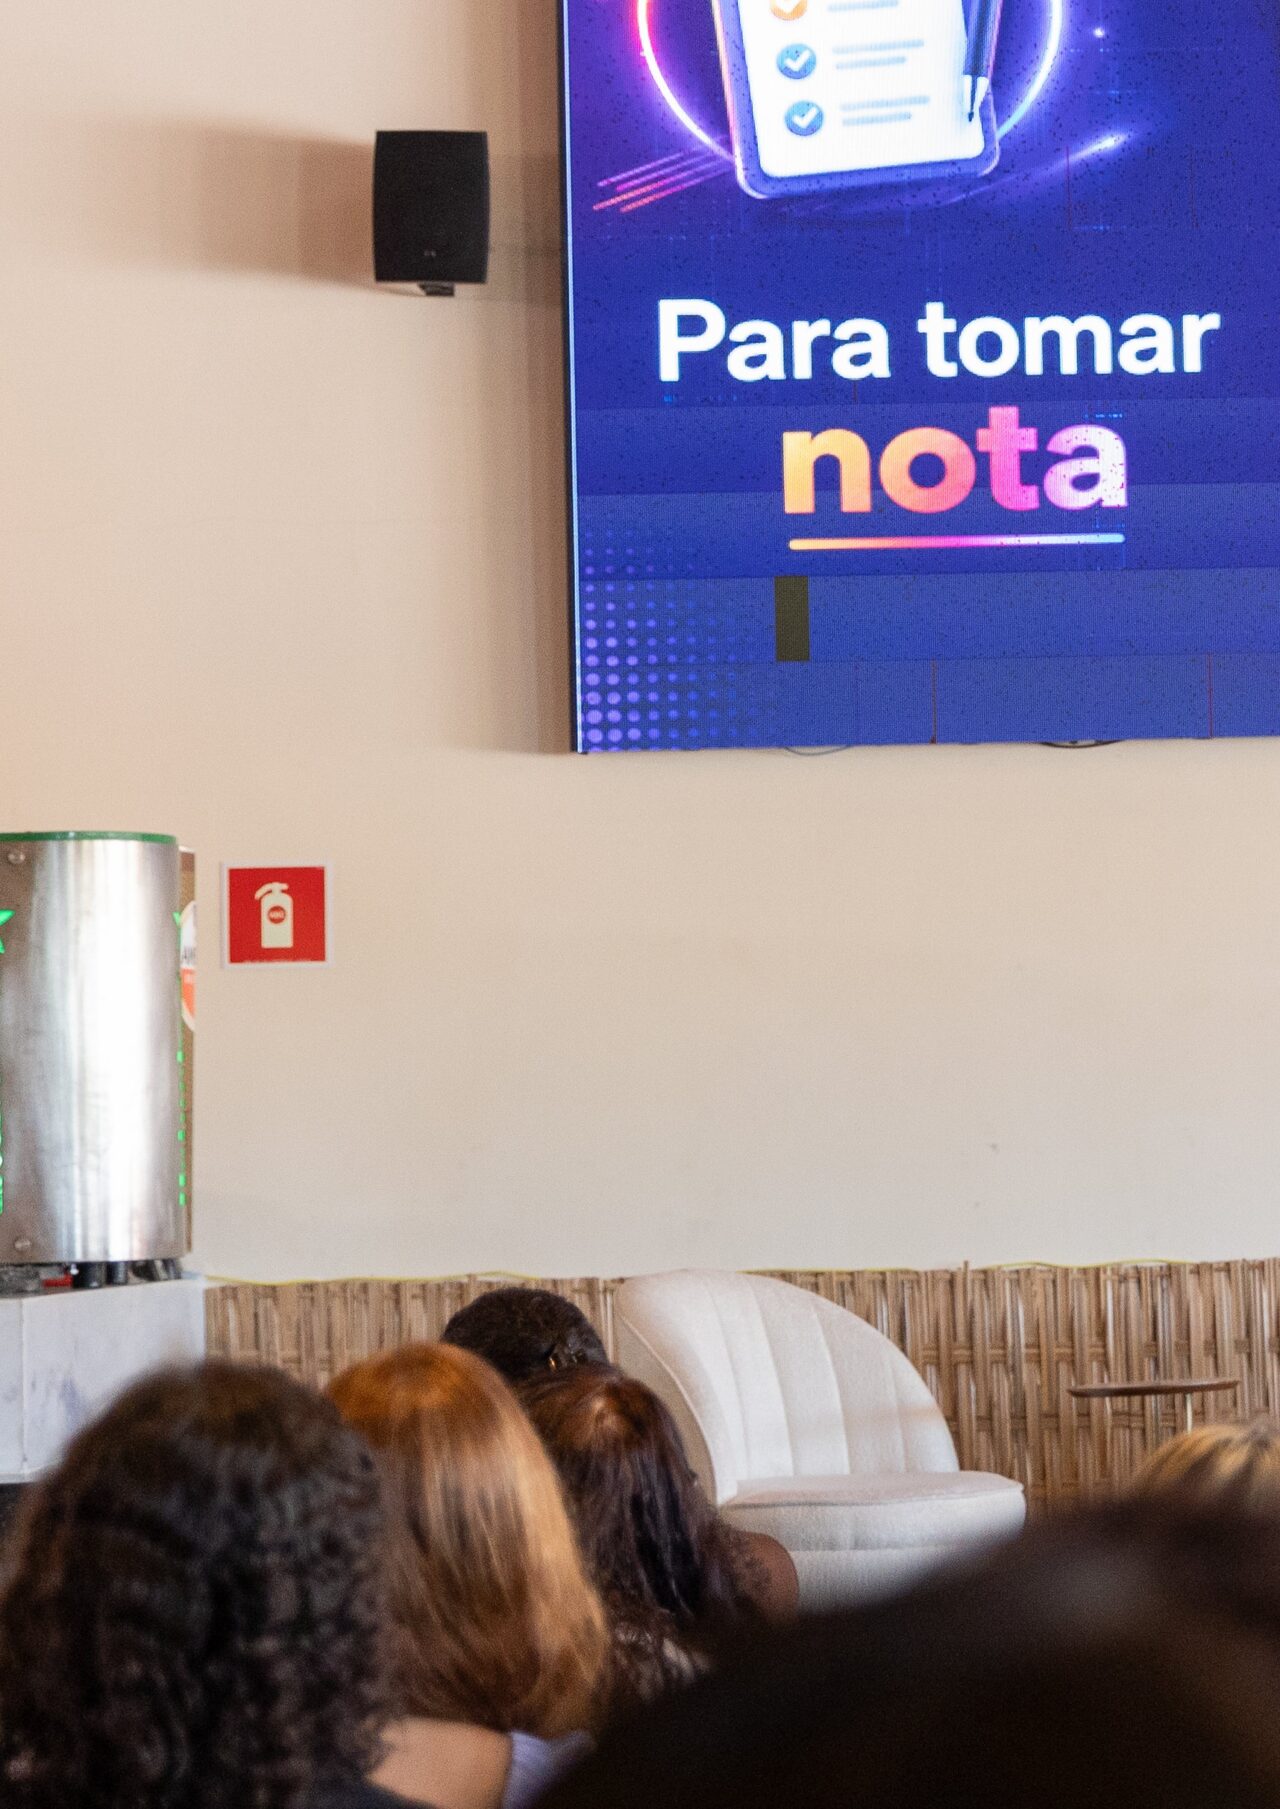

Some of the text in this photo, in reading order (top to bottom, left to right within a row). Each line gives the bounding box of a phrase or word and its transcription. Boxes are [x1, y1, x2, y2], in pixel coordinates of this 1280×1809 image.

[658, 298, 1221, 382] Para tomar
[782, 405, 1128, 515] nota
